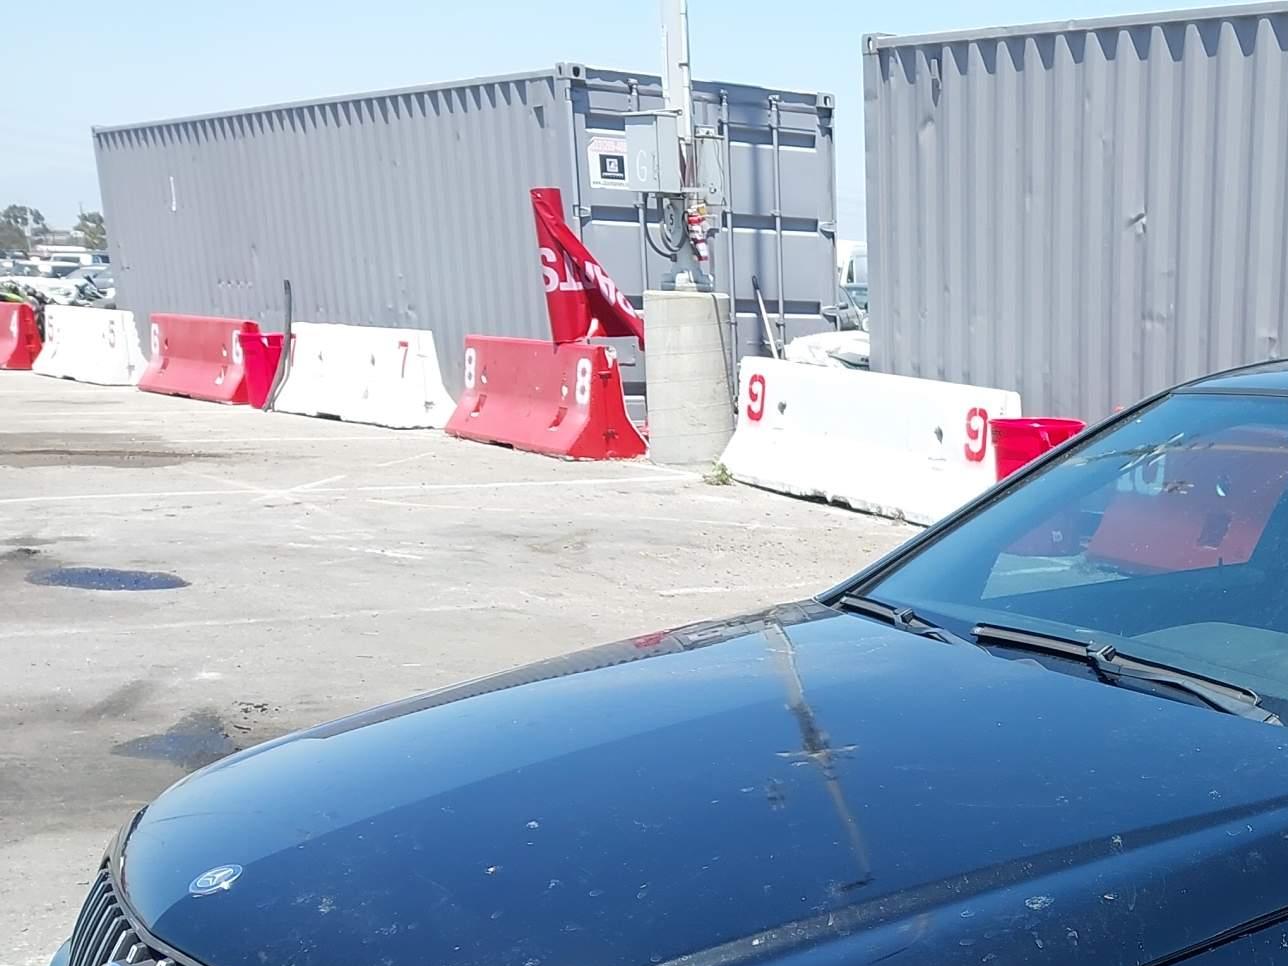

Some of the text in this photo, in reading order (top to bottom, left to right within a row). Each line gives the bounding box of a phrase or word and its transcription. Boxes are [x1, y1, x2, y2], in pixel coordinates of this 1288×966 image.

[151, 323, 160, 355] 6
[232, 330, 243, 365] 6
[398, 341, 408, 378] 7
[465, 347, 476, 389] 8
[575, 358, 592, 405] 8
[747, 374, 766, 421] 9
[964, 407, 988, 462] 9
